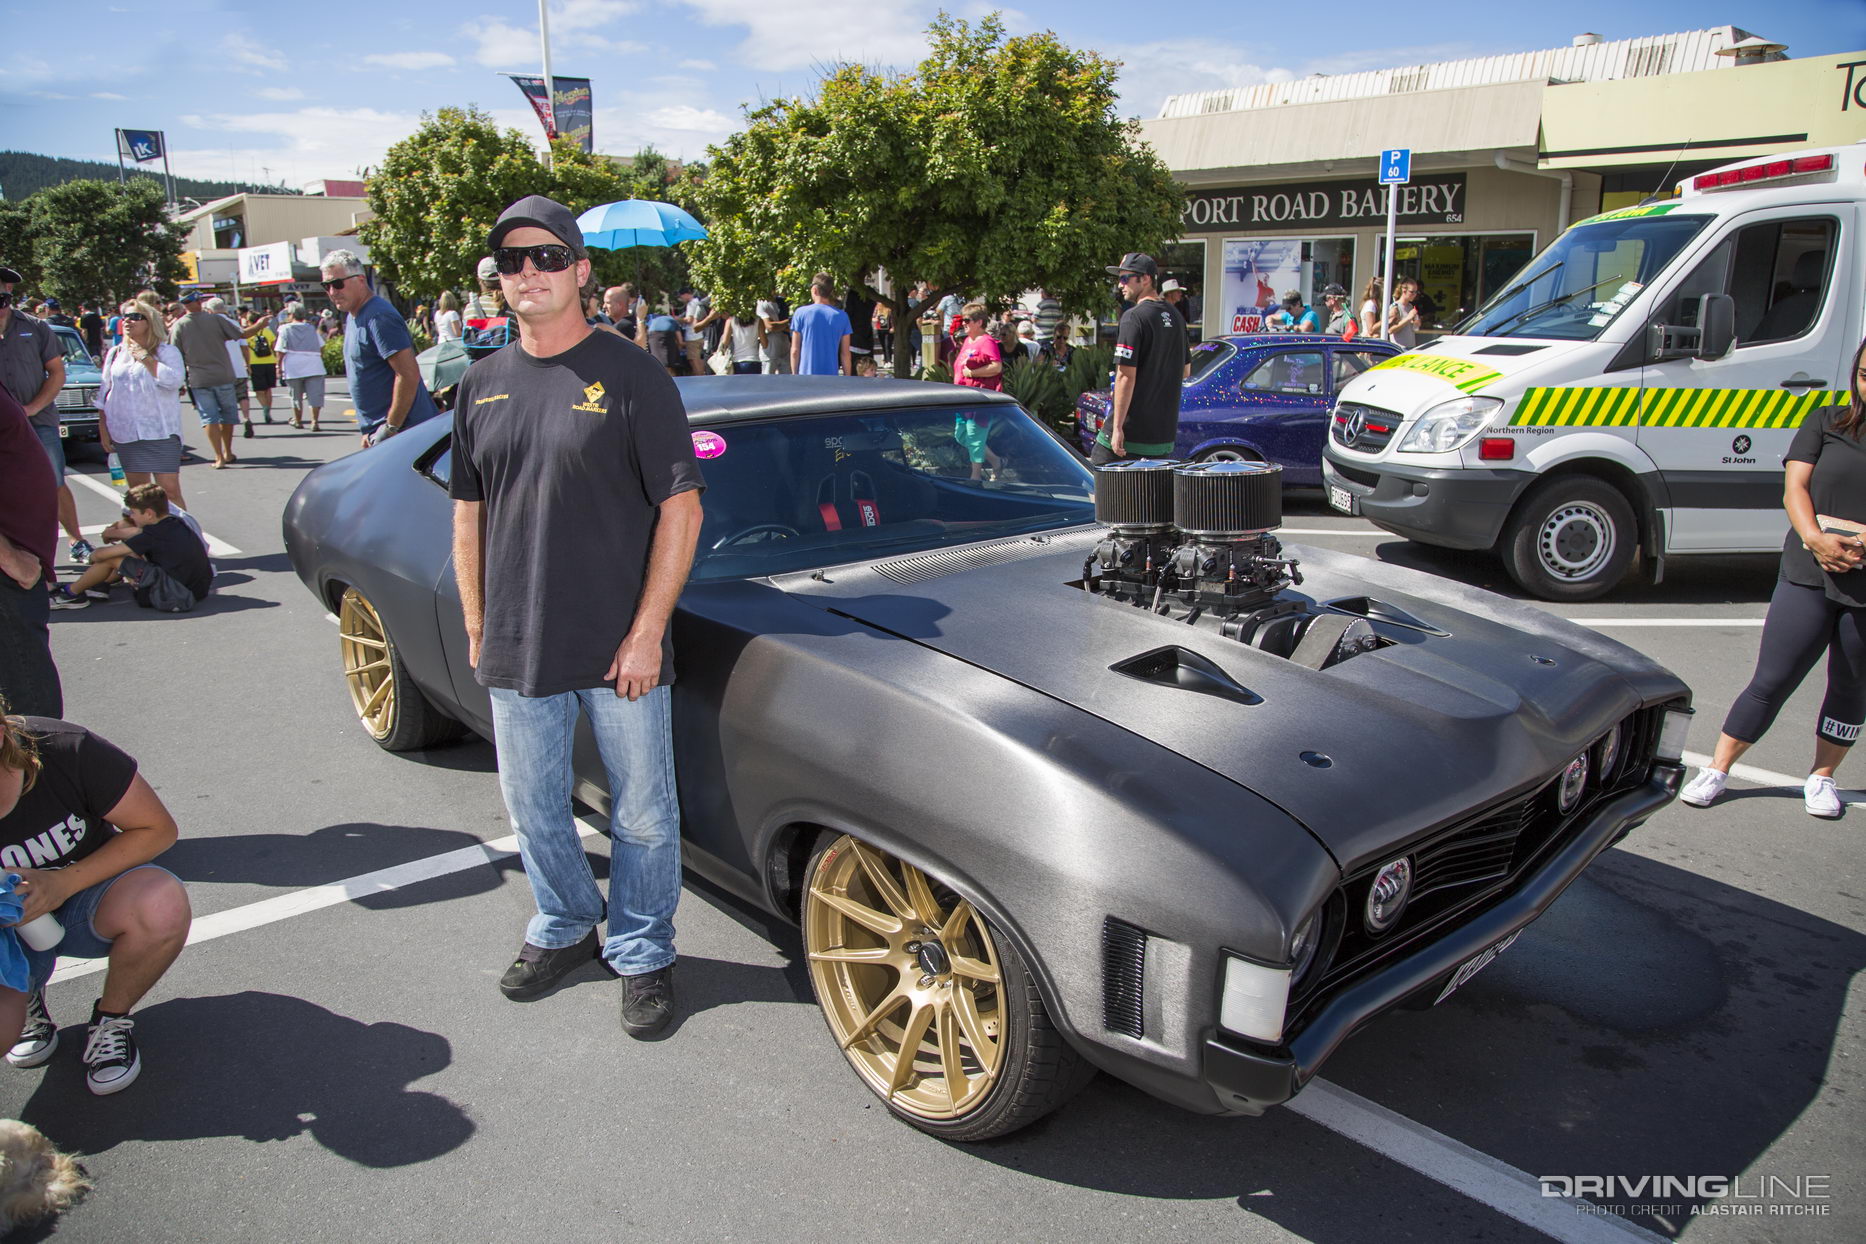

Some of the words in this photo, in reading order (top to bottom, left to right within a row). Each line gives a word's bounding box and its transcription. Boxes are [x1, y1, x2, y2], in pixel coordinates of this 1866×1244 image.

[1390, 151, 1401, 165] P
[1388, 166, 1400, 177] 60
[1179, 196, 1244, 225] PORT
[1251, 191, 1330, 222] ROAD
[1339, 183, 1463, 219] BAKERY
[1445, 213, 1462, 224] 654
[1233, 315, 1261, 333] CASH
[1486, 426, 1525, 434] Northern
[1526, 426, 1555, 437] Region
[1733, 456, 1756, 464] John
[0, 812, 87, 869] ONES
